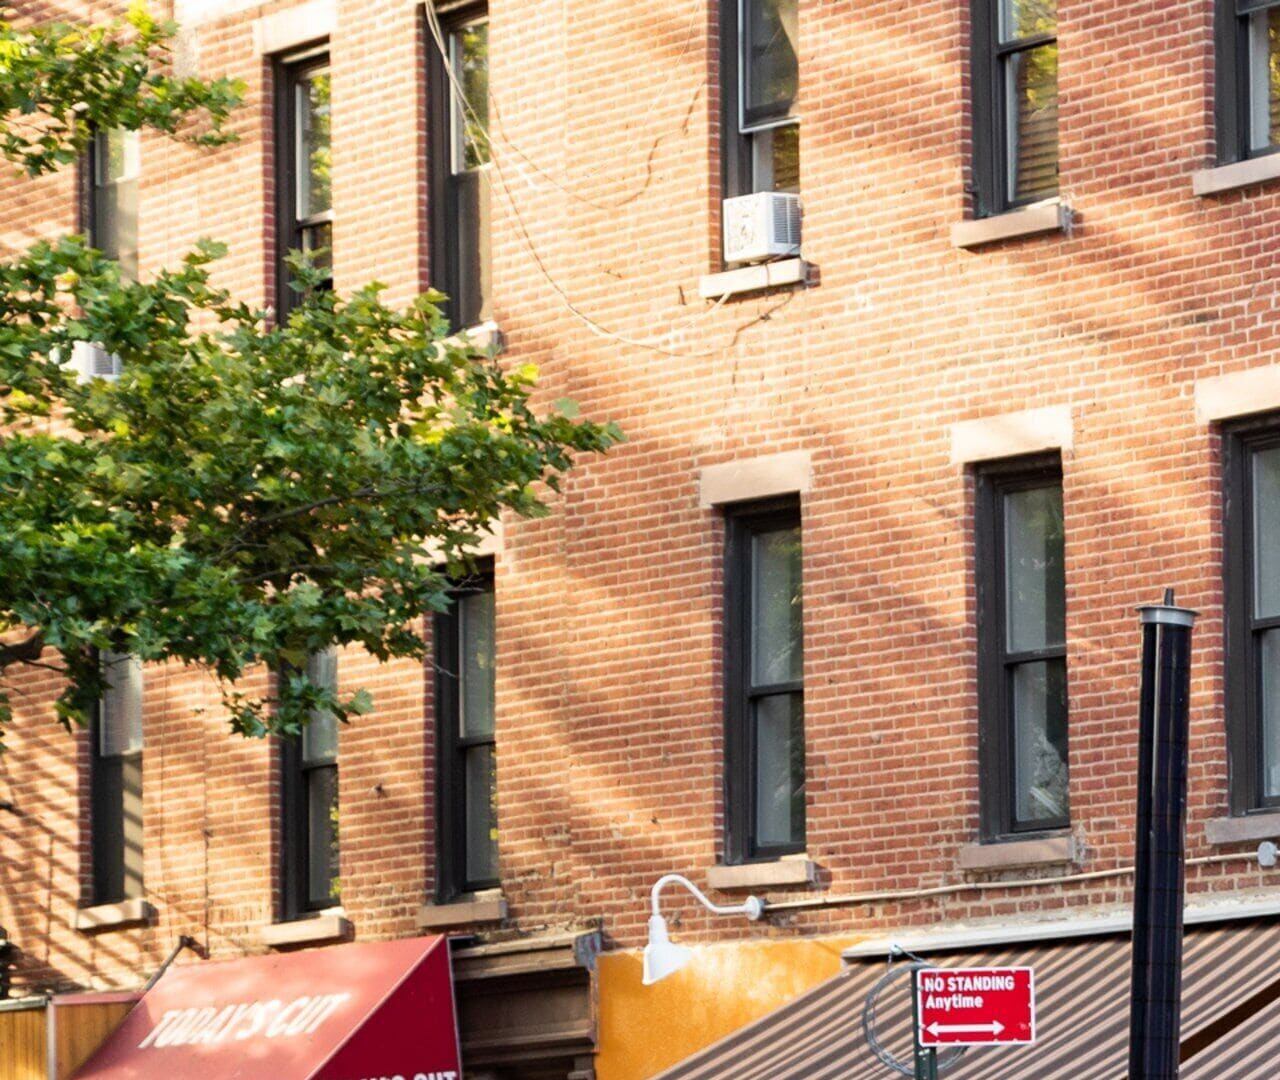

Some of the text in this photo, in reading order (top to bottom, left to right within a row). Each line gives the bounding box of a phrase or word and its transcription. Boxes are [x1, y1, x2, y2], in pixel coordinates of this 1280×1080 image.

[924, 976, 1015, 992] NO STANDING
[925, 993, 983, 1012] Anytime
[138, 993, 352, 1049] TODAY'S CUT
